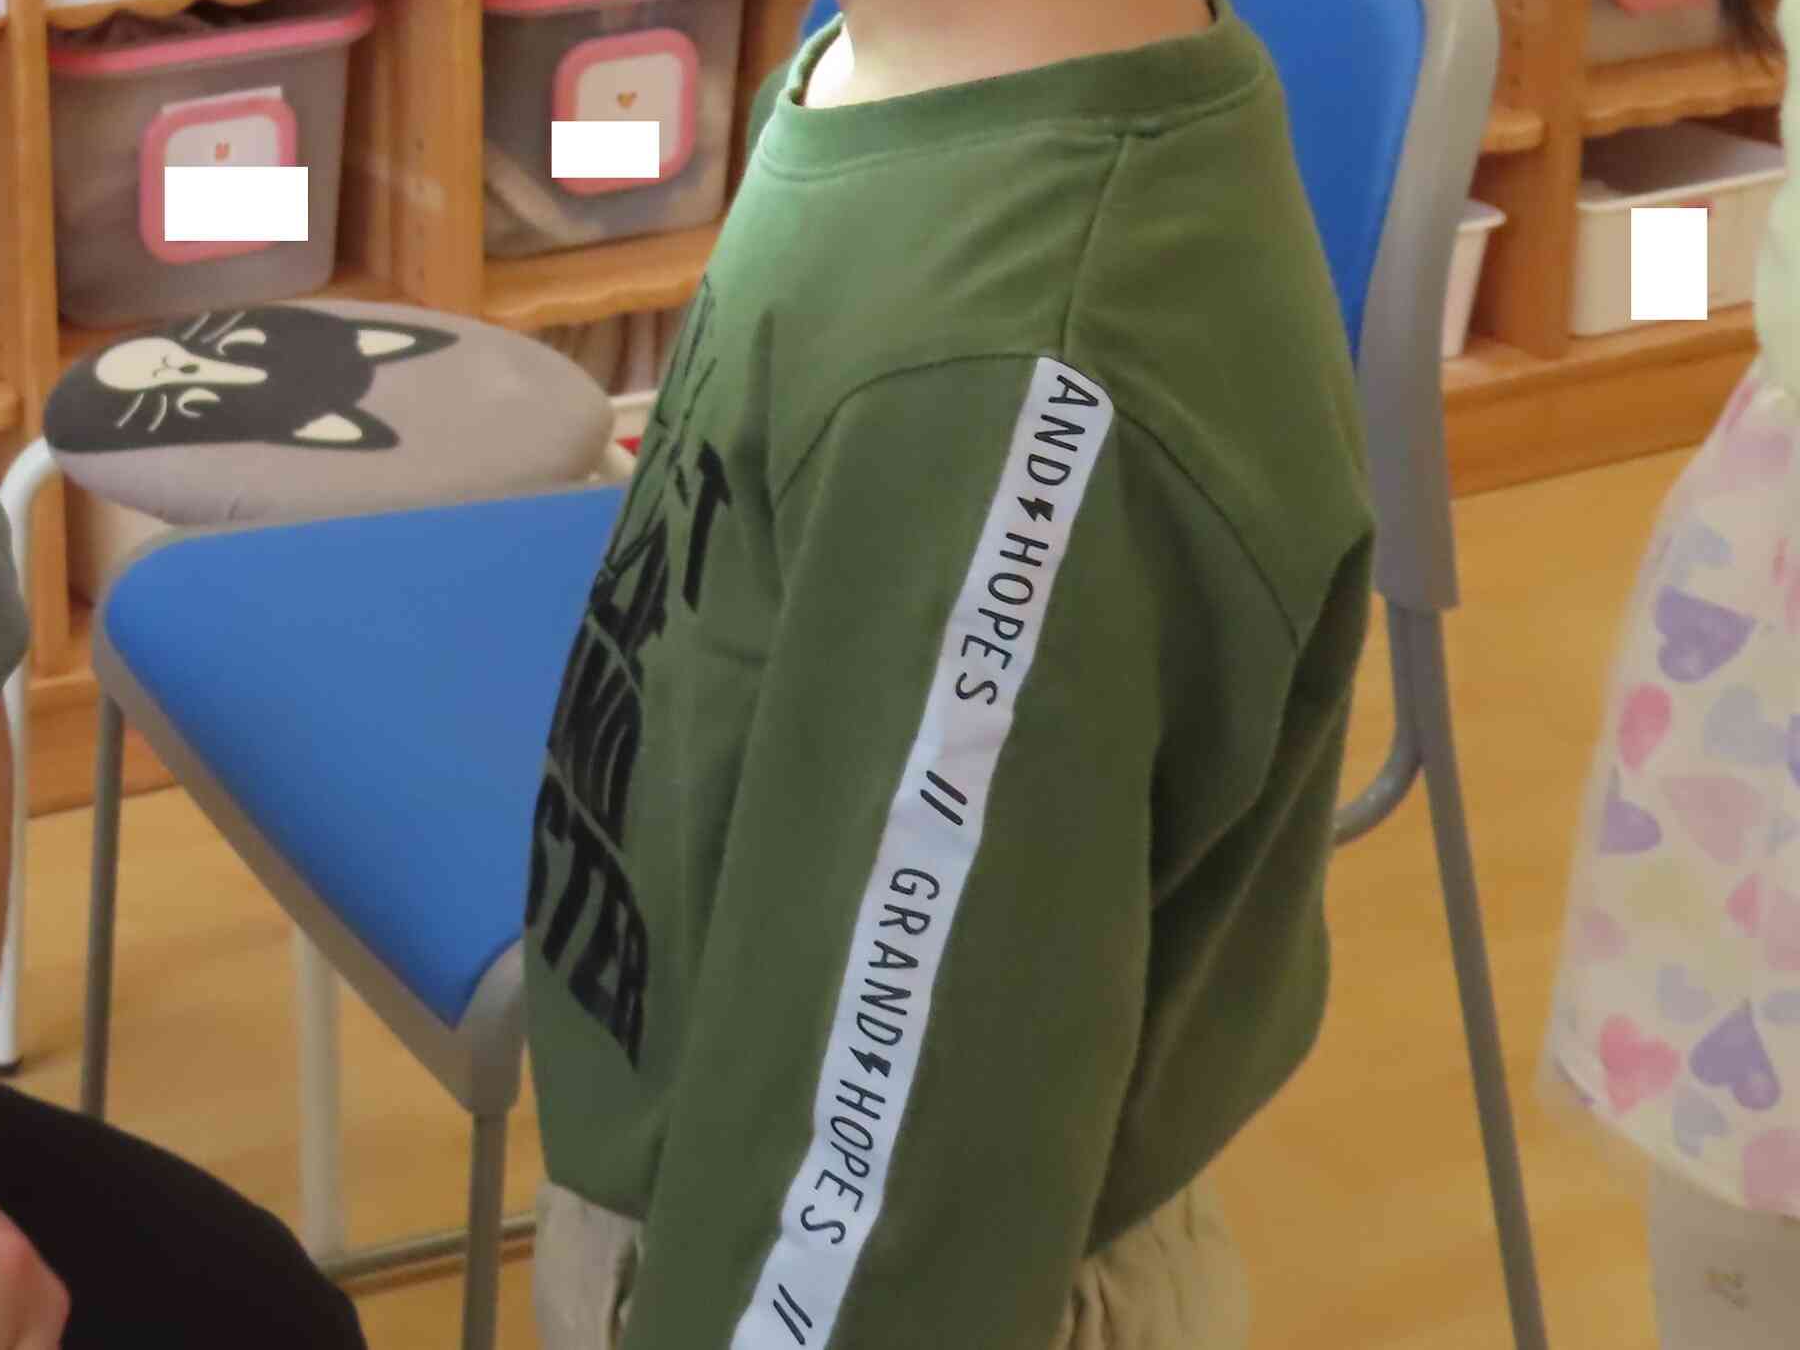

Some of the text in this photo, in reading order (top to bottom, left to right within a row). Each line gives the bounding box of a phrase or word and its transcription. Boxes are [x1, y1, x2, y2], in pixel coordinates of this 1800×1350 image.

[1026, 374, 1099, 486] AND
[955, 532, 1050, 706] HOPES
[856, 868, 940, 1046] GRAND
[800, 1079, 886, 1245] HOPES
